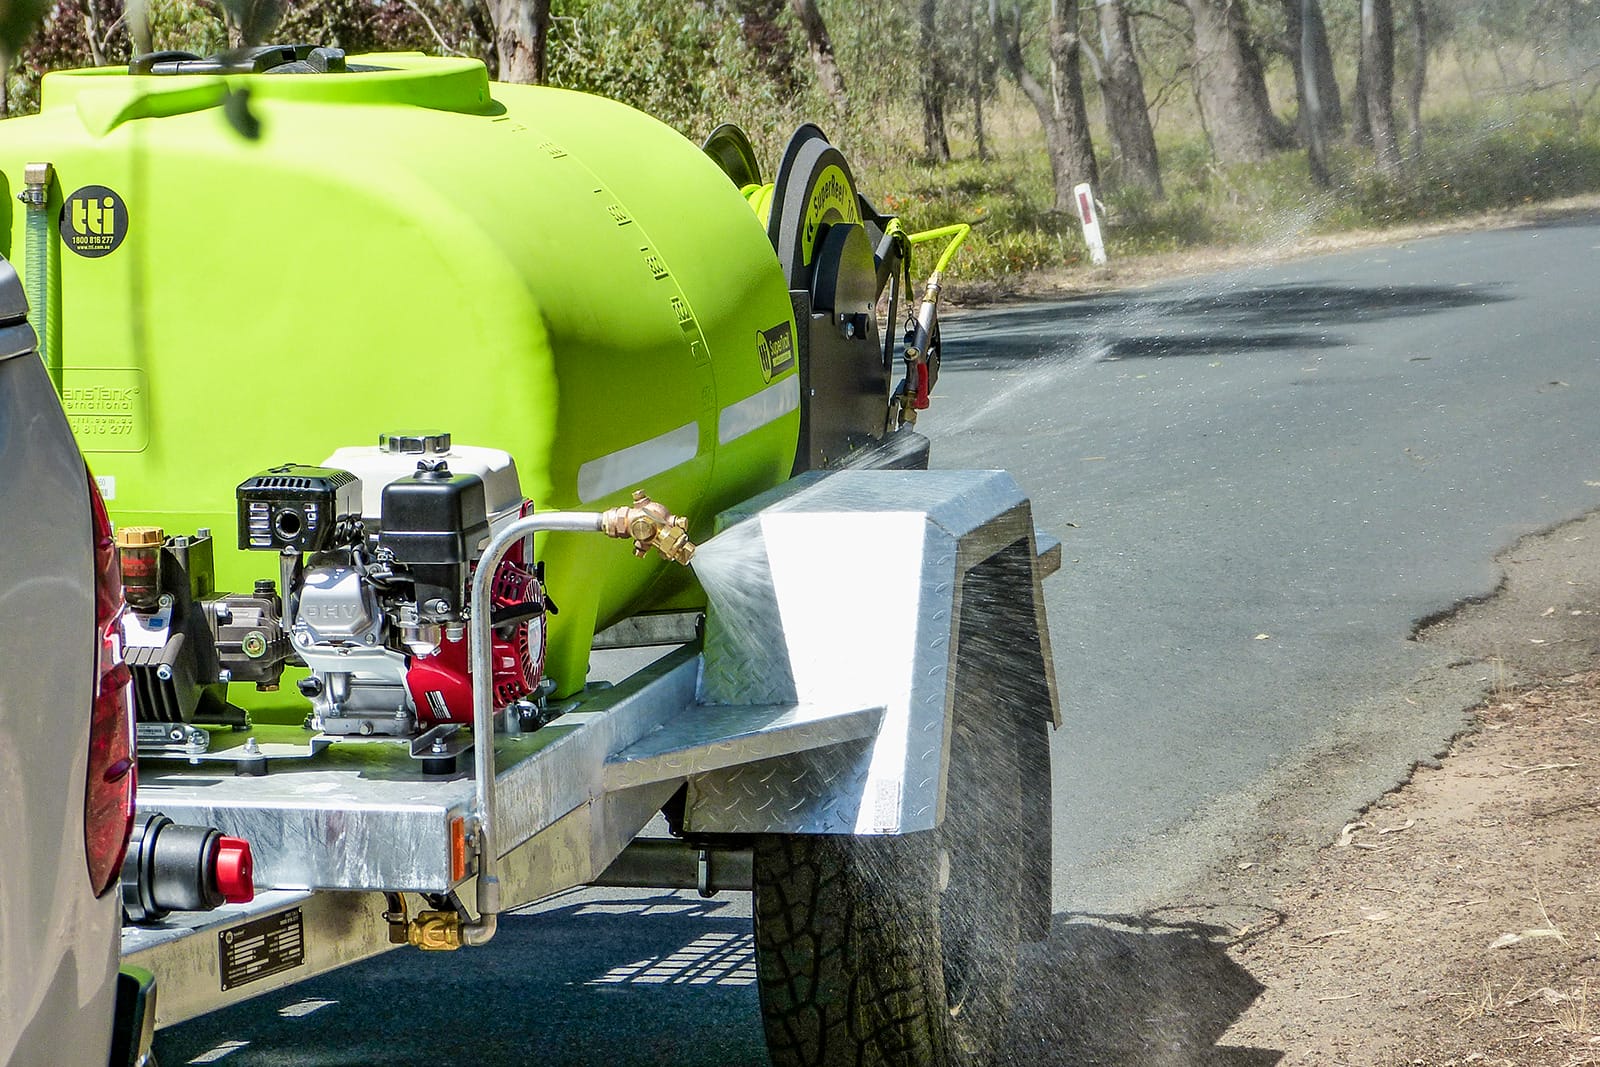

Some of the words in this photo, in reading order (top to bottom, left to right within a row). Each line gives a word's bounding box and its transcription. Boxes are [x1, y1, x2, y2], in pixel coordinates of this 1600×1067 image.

[72, 197, 114, 235] tti
[72, 236, 88, 244] 1800
[89, 236, 101, 244] 816
[102, 236, 114, 244] 277
[63, 386, 133, 401] ansTank
[84, 425, 106, 434] 816
[111, 425, 133, 434] 277
